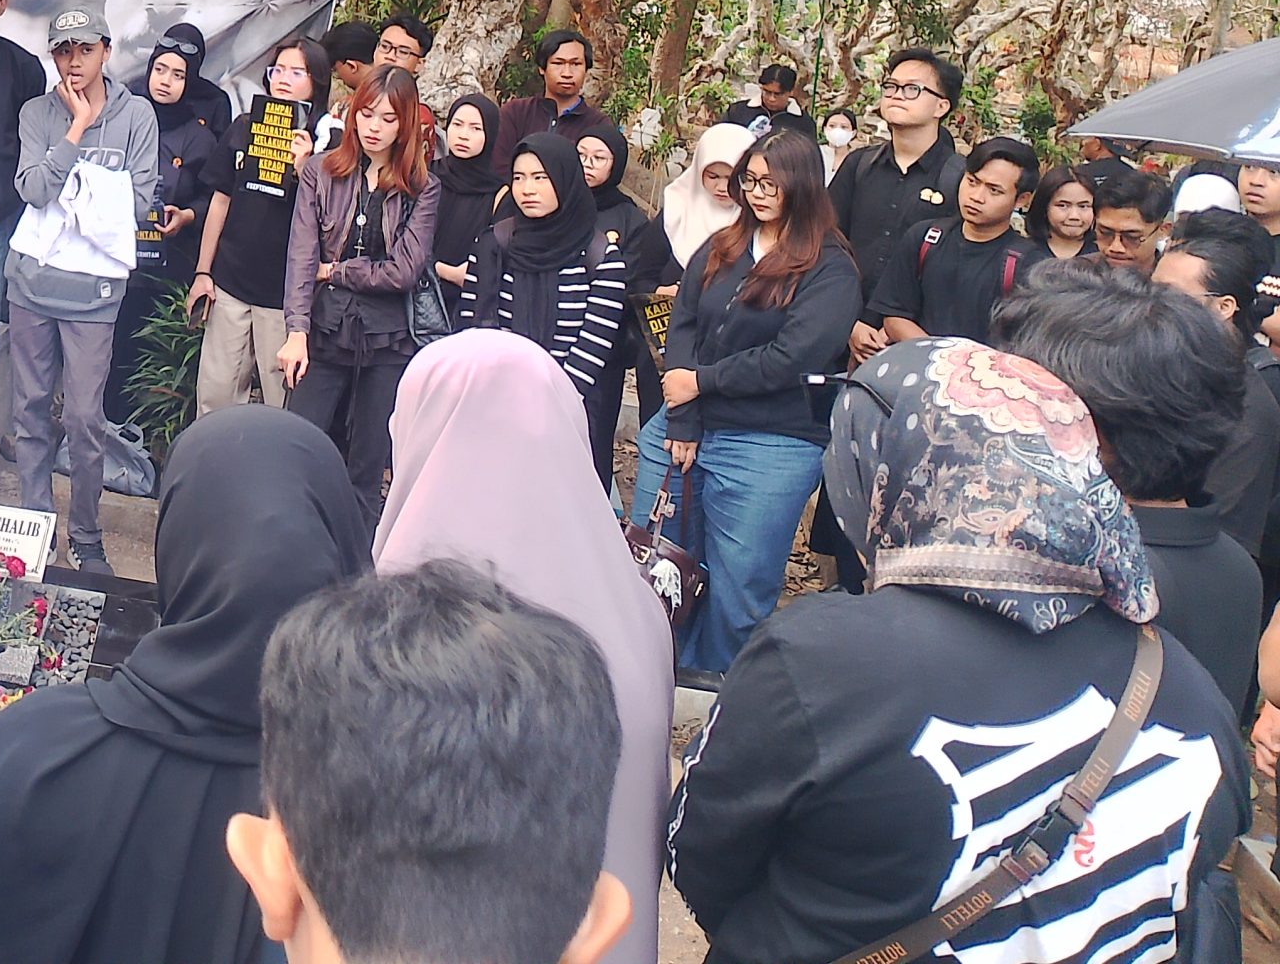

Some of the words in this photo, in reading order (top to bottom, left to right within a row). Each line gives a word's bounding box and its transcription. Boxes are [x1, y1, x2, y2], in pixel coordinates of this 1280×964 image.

[265, 102, 293, 117] SAMPAI
[1124, 669, 1153, 722] ROTELLI
[1080, 756, 1111, 797] TELLI
[939, 889, 993, 932] ROTELLI
